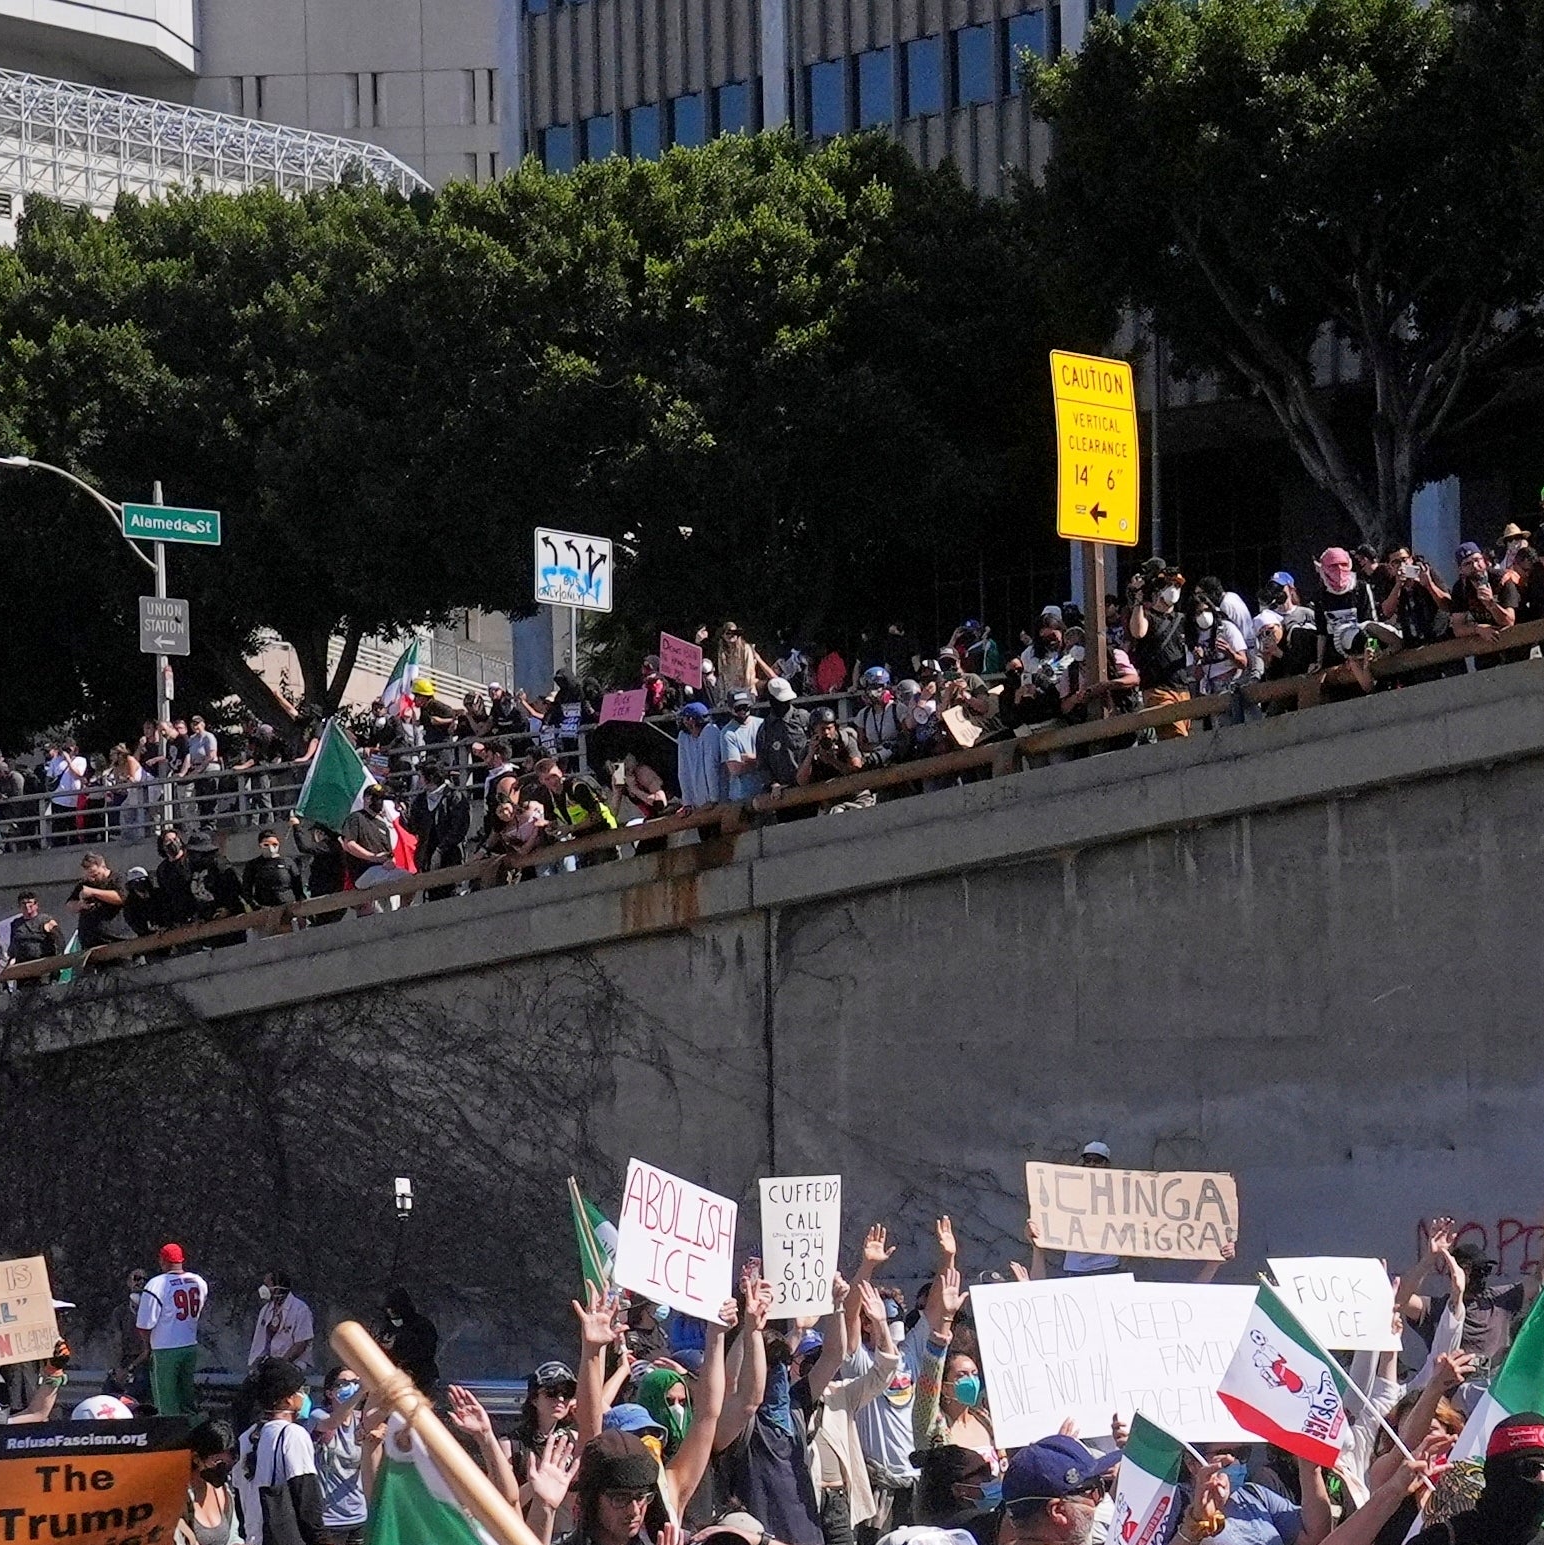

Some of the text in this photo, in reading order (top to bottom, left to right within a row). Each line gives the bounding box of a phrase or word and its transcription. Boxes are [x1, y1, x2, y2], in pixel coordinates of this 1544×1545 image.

[1062, 364, 1124, 395] CAUTION
[1072, 411, 1122, 434] VERTICAL
[1068, 435, 1128, 459] CLEARANCE
[1075, 464, 1123, 490] 14' 6"
[131, 513, 212, 534] Alameda St
[563, 574, 580, 587] BUS
[538, 586, 583, 602] ONLY ONLY
[146, 602, 182, 617] UNION
[144, 619, 185, 635] STATION
[768, 1181, 839, 1203] CUFFED?
[623, 1167, 734, 1259] ABOLISH
[785, 1212, 822, 1230] CALL
[1040, 1212, 1089, 1250] LA
[782, 1238, 824, 1258] 424
[5, 1264, 33, 1291] IS
[647, 1238, 706, 1302] ICE
[783, 1259, 824, 1281] 610
[777, 1278, 827, 1304] 3020
[1293, 1273, 1375, 1305] FUCK
[173, 1286, 201, 1321] 96
[988, 1292, 1087, 1366] SPREAD
[1110, 1299, 1194, 1342] KEEP
[1328, 1310, 1367, 1340] ICE
[990, 1357, 1083, 1423] LOVE NOT
[6, 1432, 148, 1451] RefuseFascism.org
[35, 1463, 115, 1493] The
